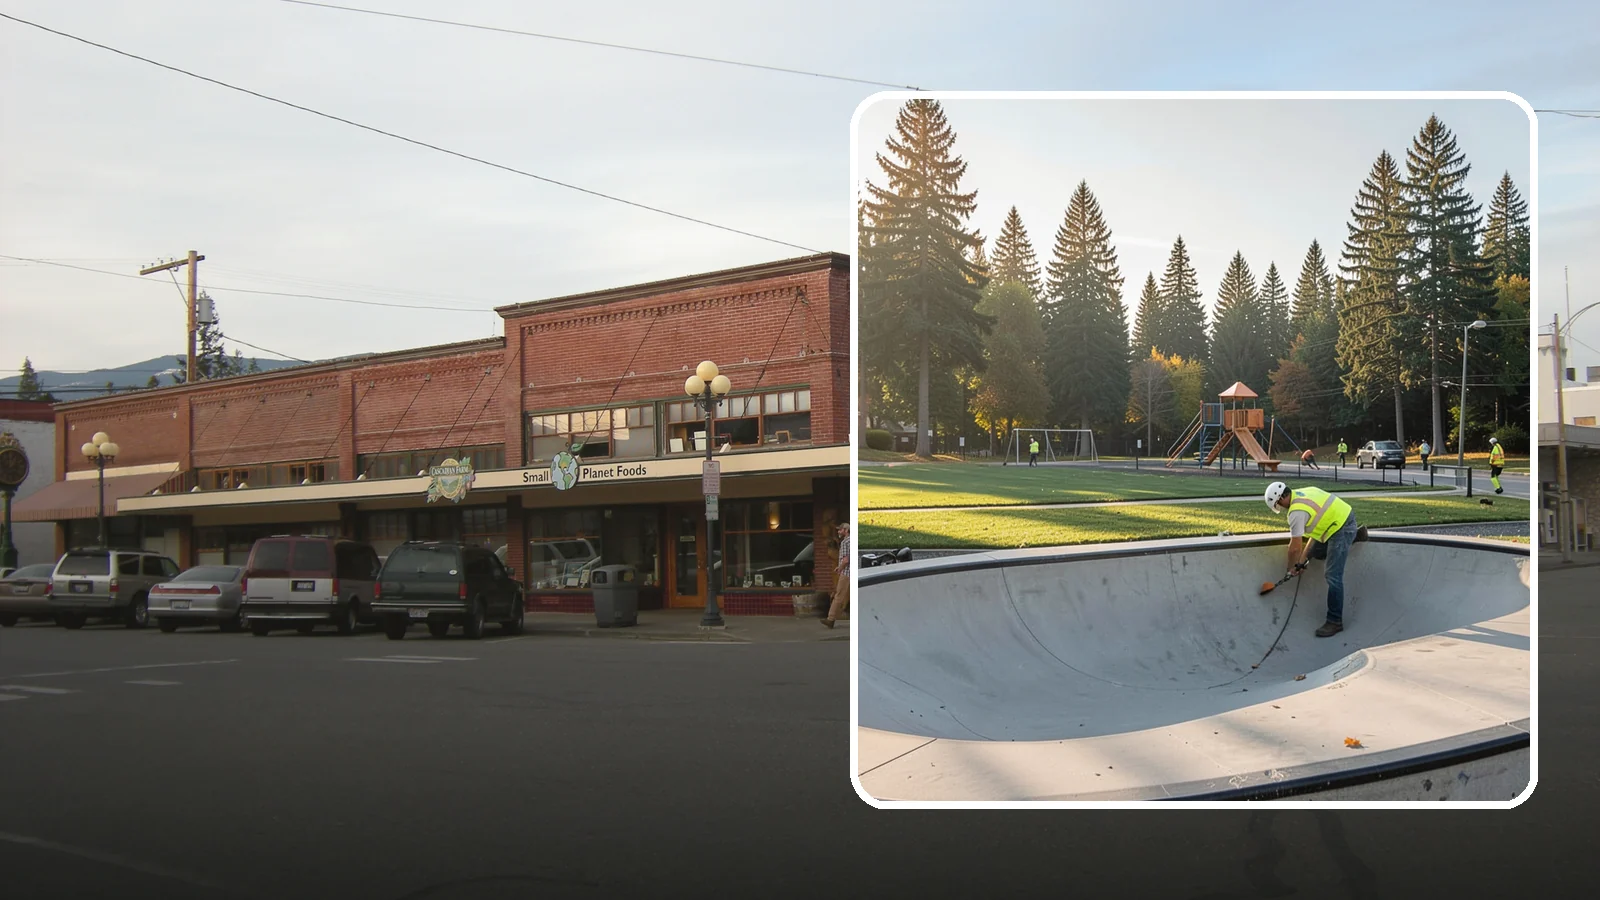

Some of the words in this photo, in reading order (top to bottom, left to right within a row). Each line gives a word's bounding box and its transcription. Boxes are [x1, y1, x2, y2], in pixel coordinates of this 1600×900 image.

[523, 471, 549, 483] Small
[582, 467, 614, 479] Planet
[617, 464, 647, 477] Foods
